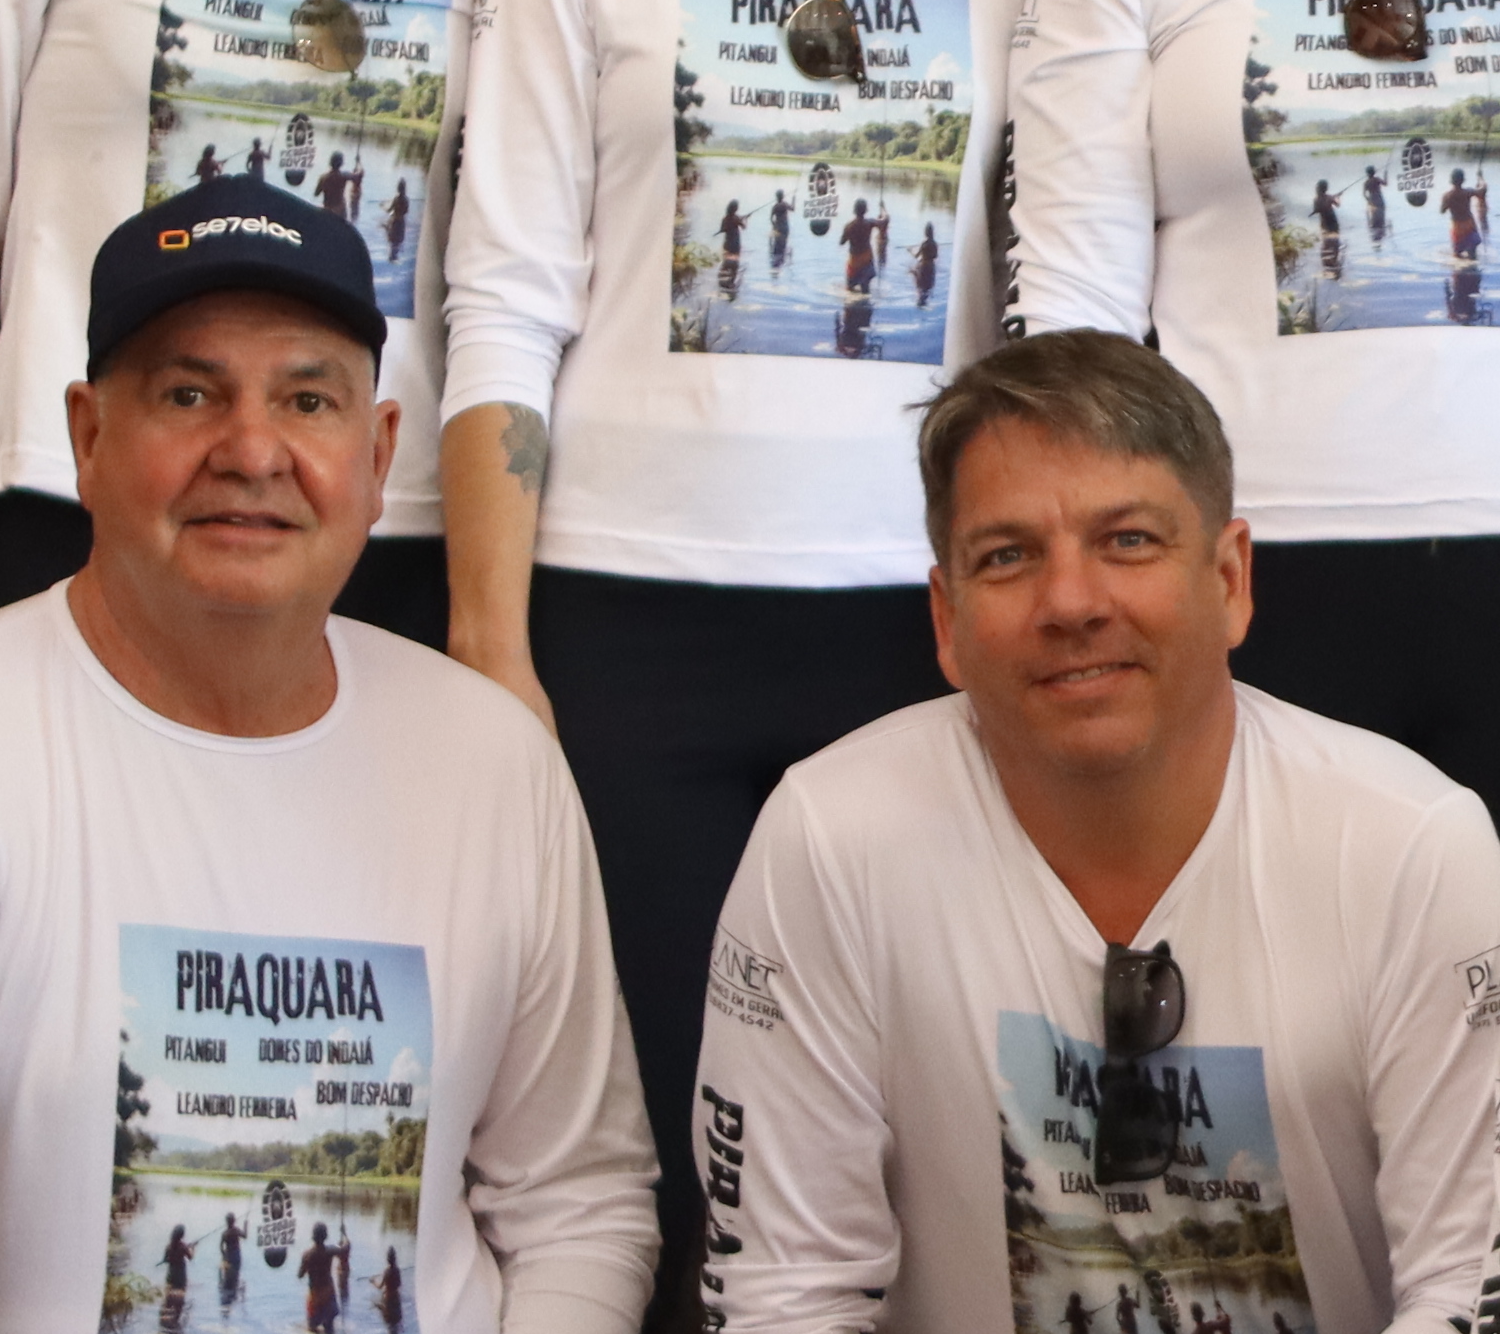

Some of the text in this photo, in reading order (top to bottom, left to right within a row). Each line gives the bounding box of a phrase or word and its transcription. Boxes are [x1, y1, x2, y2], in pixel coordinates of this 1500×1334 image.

[214, 34, 268, 59] LEANDRO
[371, 38, 430, 62] DESPACHO
[1439, 27, 1456, 46] DO
[718, 40, 911, 67] PITANGUI INDAIÁ
[1307, 72, 1371, 91] LEANDRO
[1376, 71, 1437, 90] FERREIRA
[1455, 55, 1487, 75] BOM
[730, 80, 953, 112] LEANDRO FERREIRA BOM DESPACHO
[191, 216, 302, 246] se7eloc
[176, 950, 385, 1026] PIRAQUARA
[165, 1034, 374, 1065] PITANGUI DORES DO INDAIÁ
[176, 1079, 413, 1121] LEANDRO FERREIRA BOM DESPACHO
